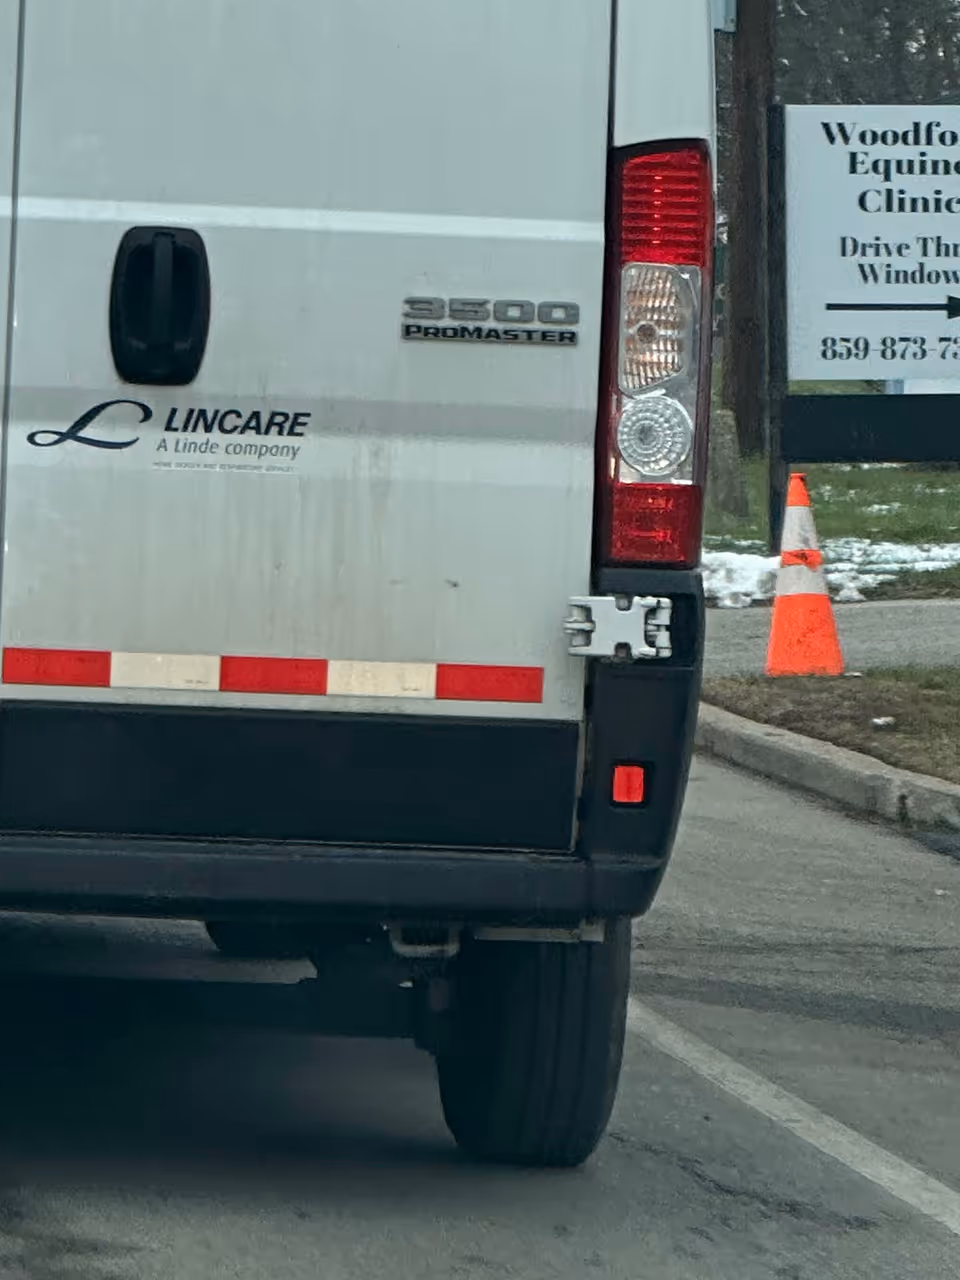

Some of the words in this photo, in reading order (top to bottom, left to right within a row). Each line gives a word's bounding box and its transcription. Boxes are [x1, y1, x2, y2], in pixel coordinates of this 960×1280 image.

[857, 188, 960, 214] Clinic
[840, 235, 911, 257] Drive
[858, 261, 960, 285] Window
[402, 296, 580, 325] 3500
[405, 324, 577, 343] PROMASTER
[163, 407, 312, 437] LINCARE
[156, 438, 168, 452] A
[174, 437, 219, 455] Linde
[225, 441, 301, 461] company
